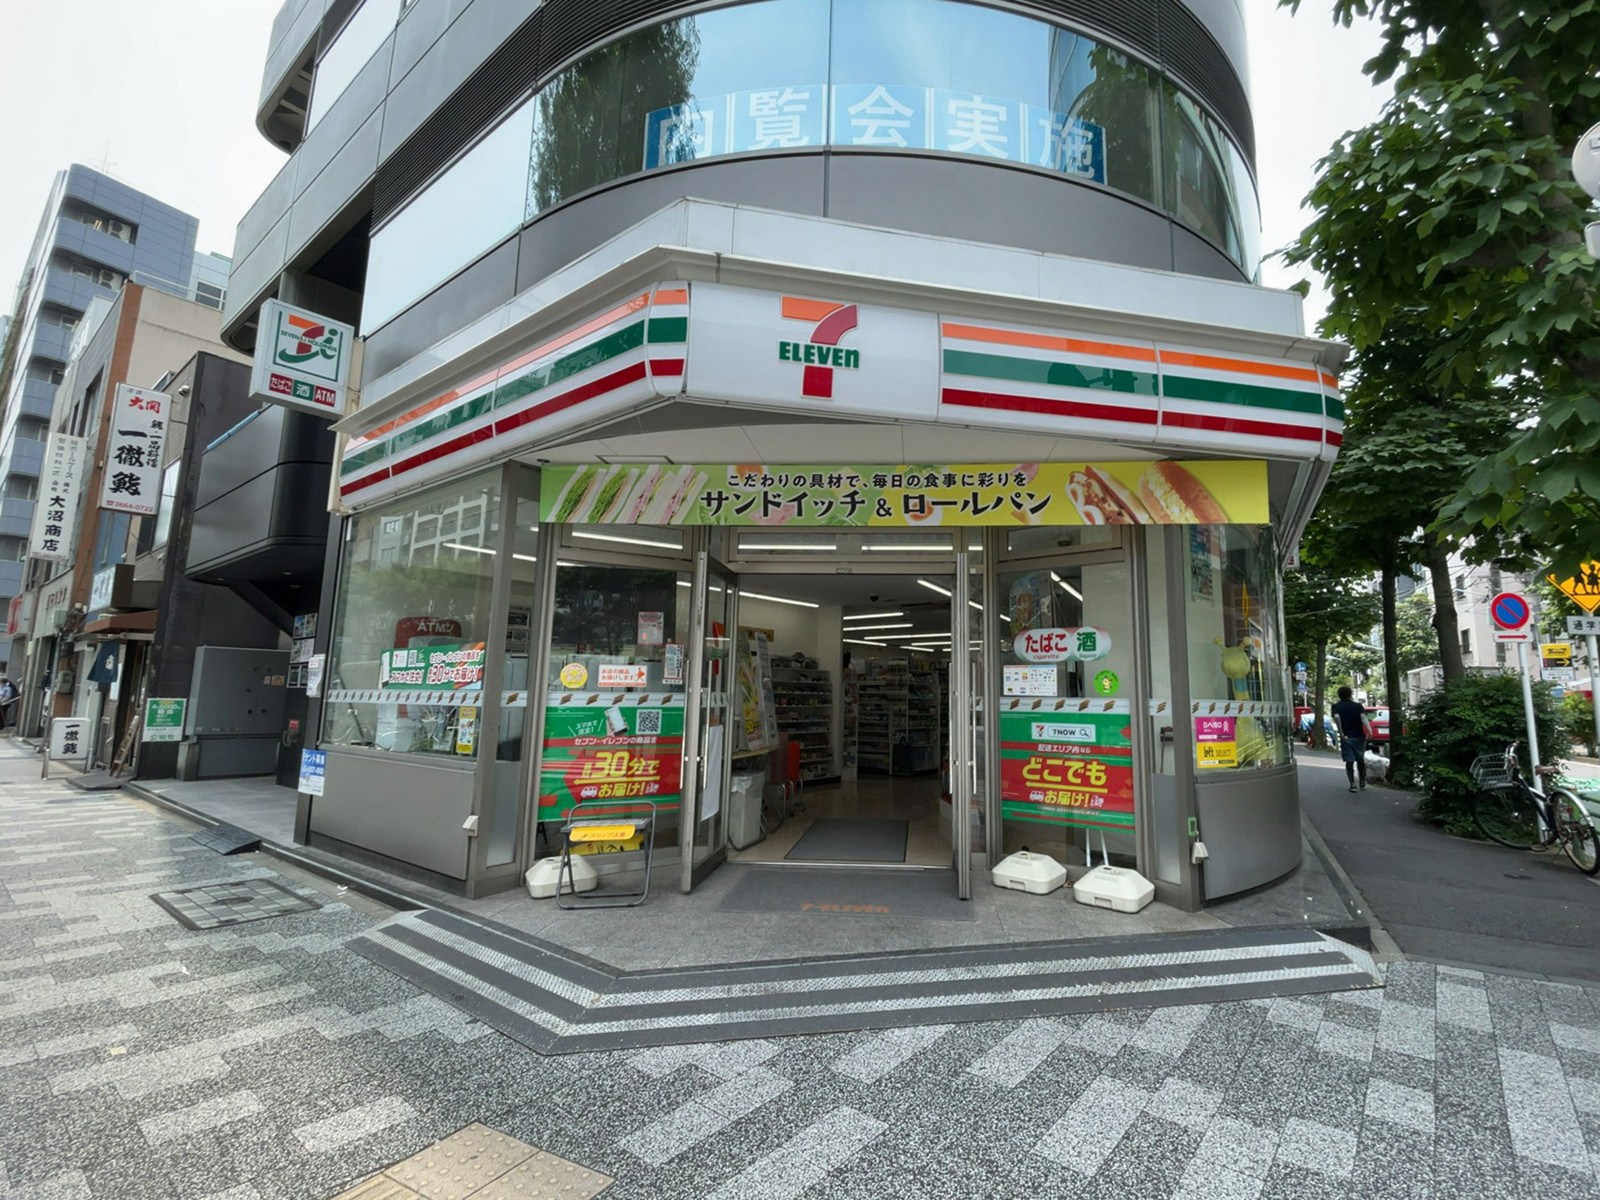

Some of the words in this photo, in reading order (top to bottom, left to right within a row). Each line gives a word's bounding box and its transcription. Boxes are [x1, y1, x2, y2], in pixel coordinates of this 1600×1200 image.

[315, 390, 335, 405] ATM
[728, 472, 1027, 489] こだわりの具材で、毎日の食事に彩りを
[701, 491, 866, 518] サンドイッチ
[876, 498, 893, 517] &
[903, 492, 1052, 516] ロールパン
[41, 495, 66, 552] 大沼商店
[1025, 633, 1068, 653] たばこ
[1077, 632, 1096, 652] 酒
[1022, 757, 1106, 786] どこでも
